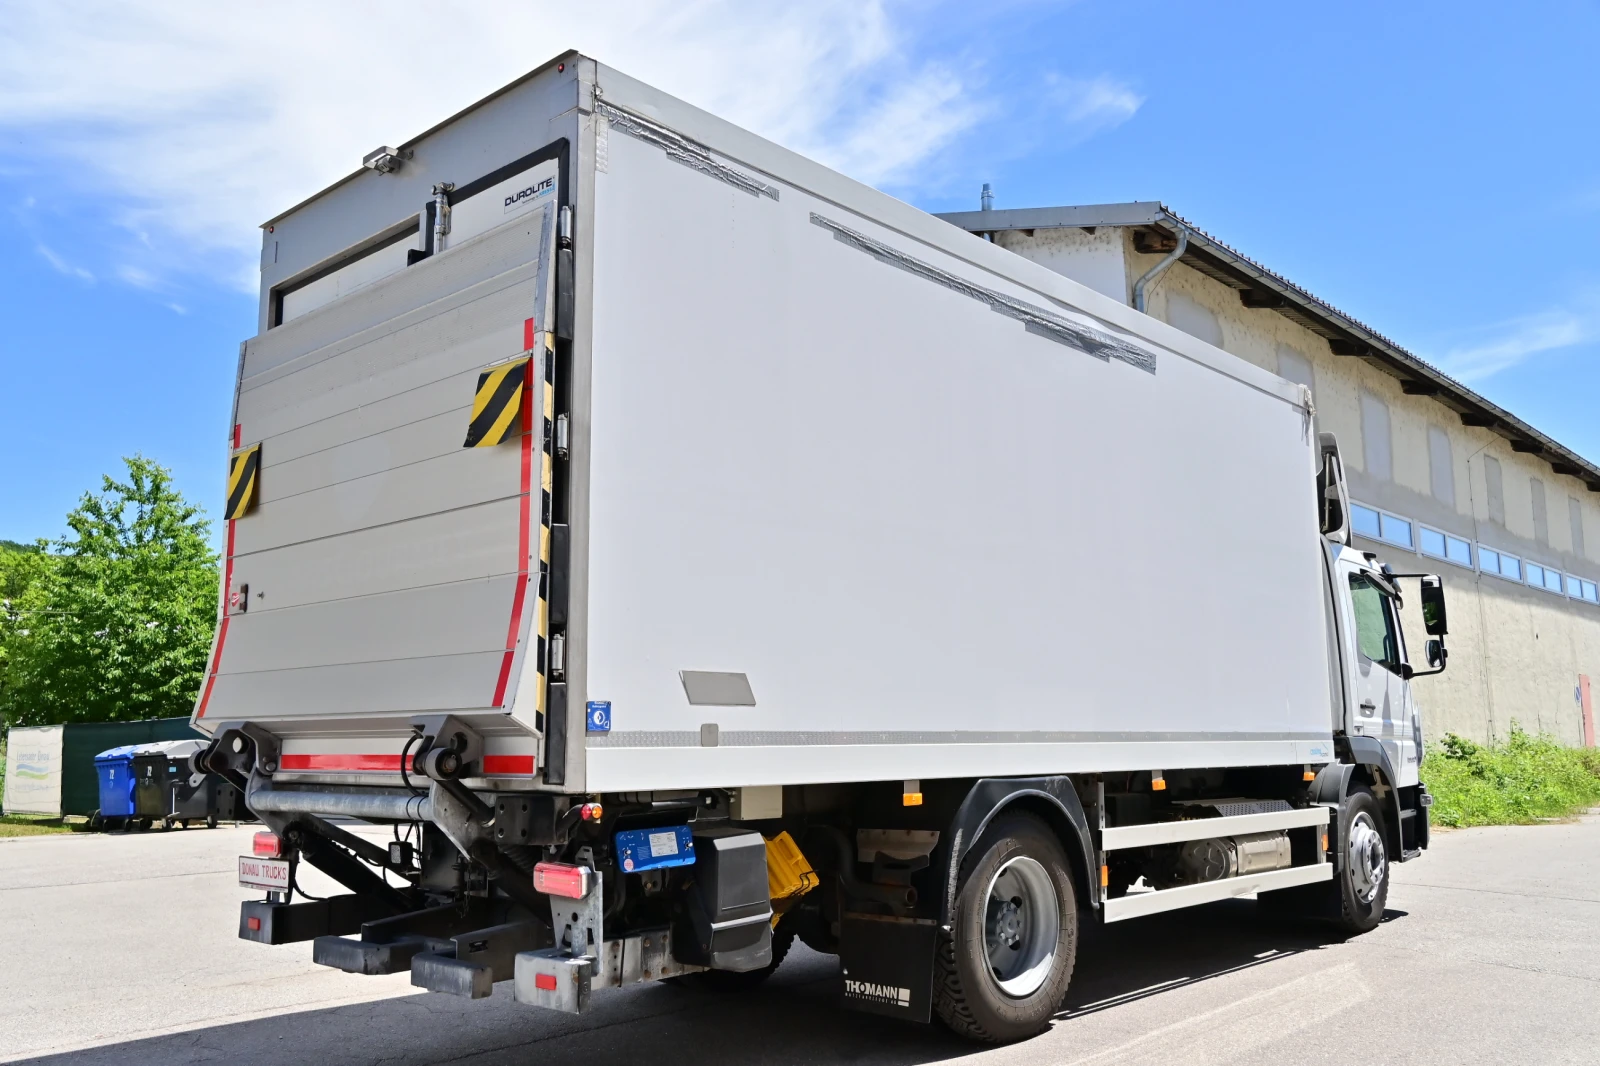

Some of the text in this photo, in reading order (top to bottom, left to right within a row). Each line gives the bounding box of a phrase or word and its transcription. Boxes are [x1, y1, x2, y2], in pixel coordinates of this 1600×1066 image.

[504, 177, 553, 207] DUROLITE
[241, 862, 287, 881] DONAU TRUCKS
[844, 979, 898, 1000] THOMANN
